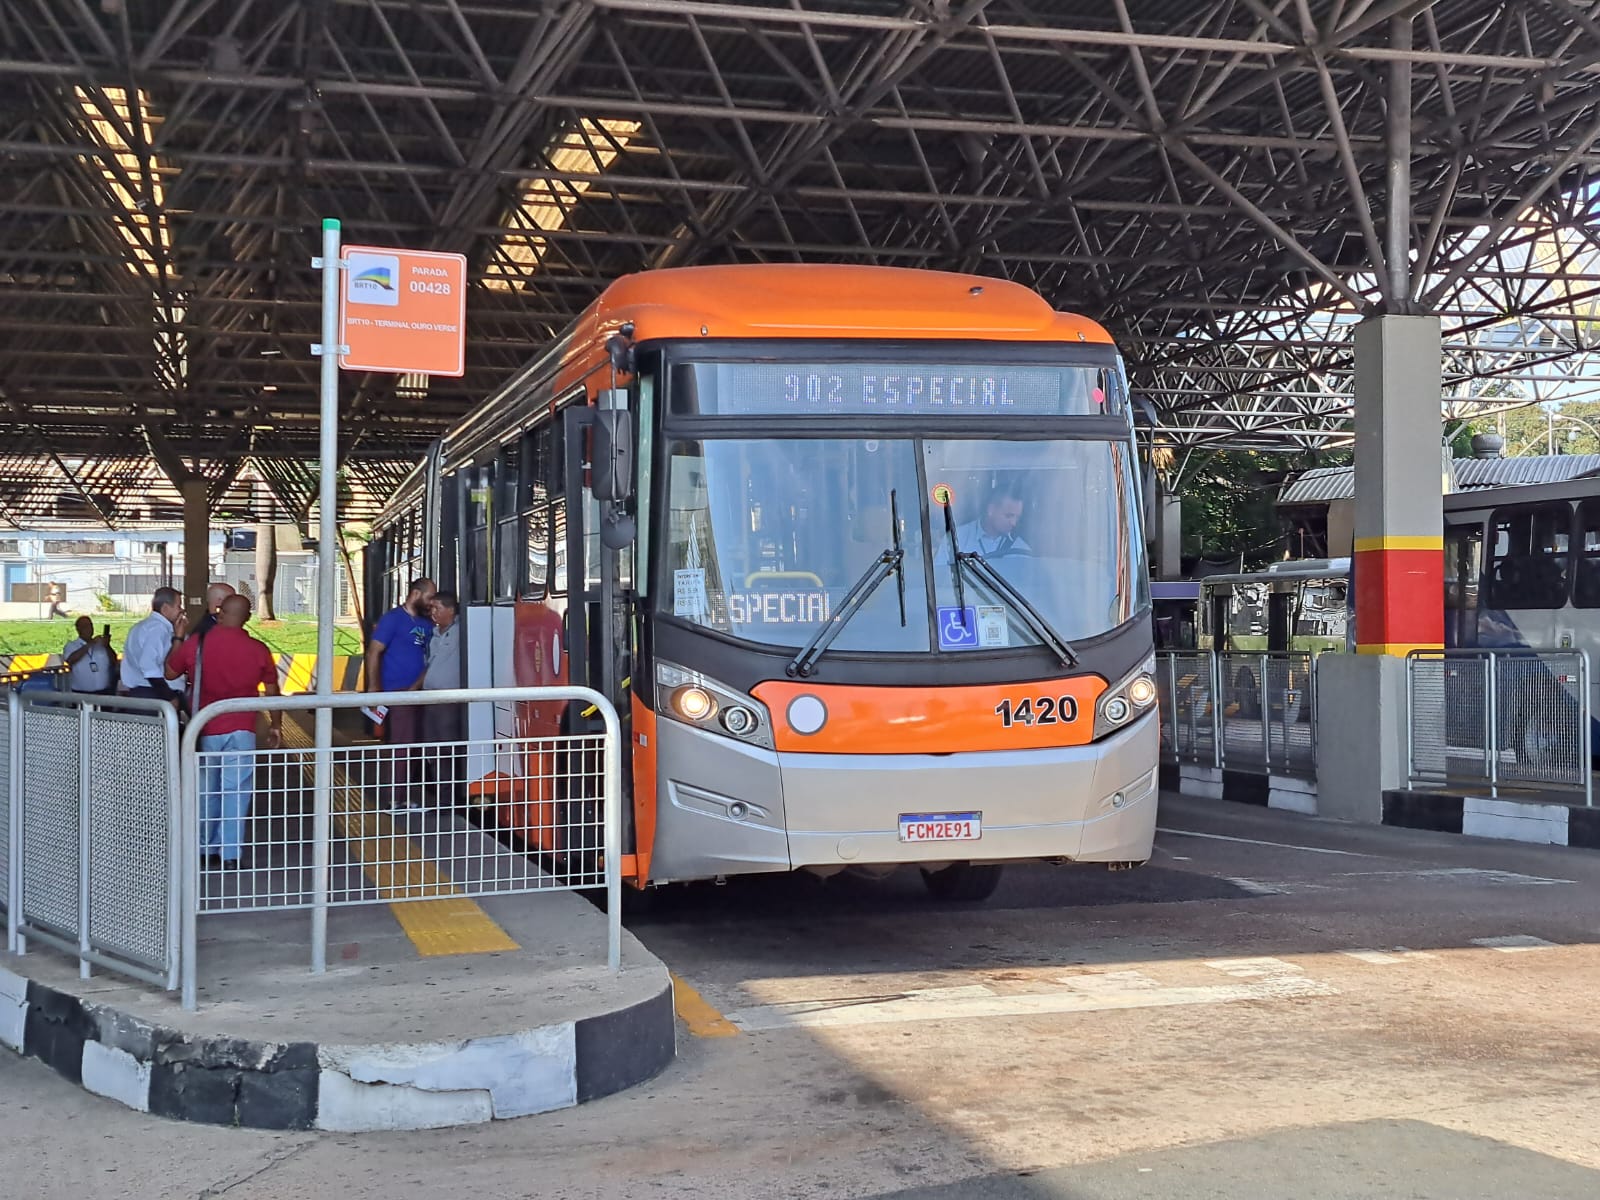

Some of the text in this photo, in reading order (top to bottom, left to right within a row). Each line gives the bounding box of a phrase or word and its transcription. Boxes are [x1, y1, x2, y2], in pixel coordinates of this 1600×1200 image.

[412, 267, 448, 277] PARADA
[409, 280, 451, 295] 00428
[374, 320, 410, 329] TERMINAL
[411, 322, 433, 331] OURO
[785, 373, 1014, 406] 902 ESPECIAL
[994, 695, 1078, 727] 1420
[907, 821, 972, 839] FCM2E91
